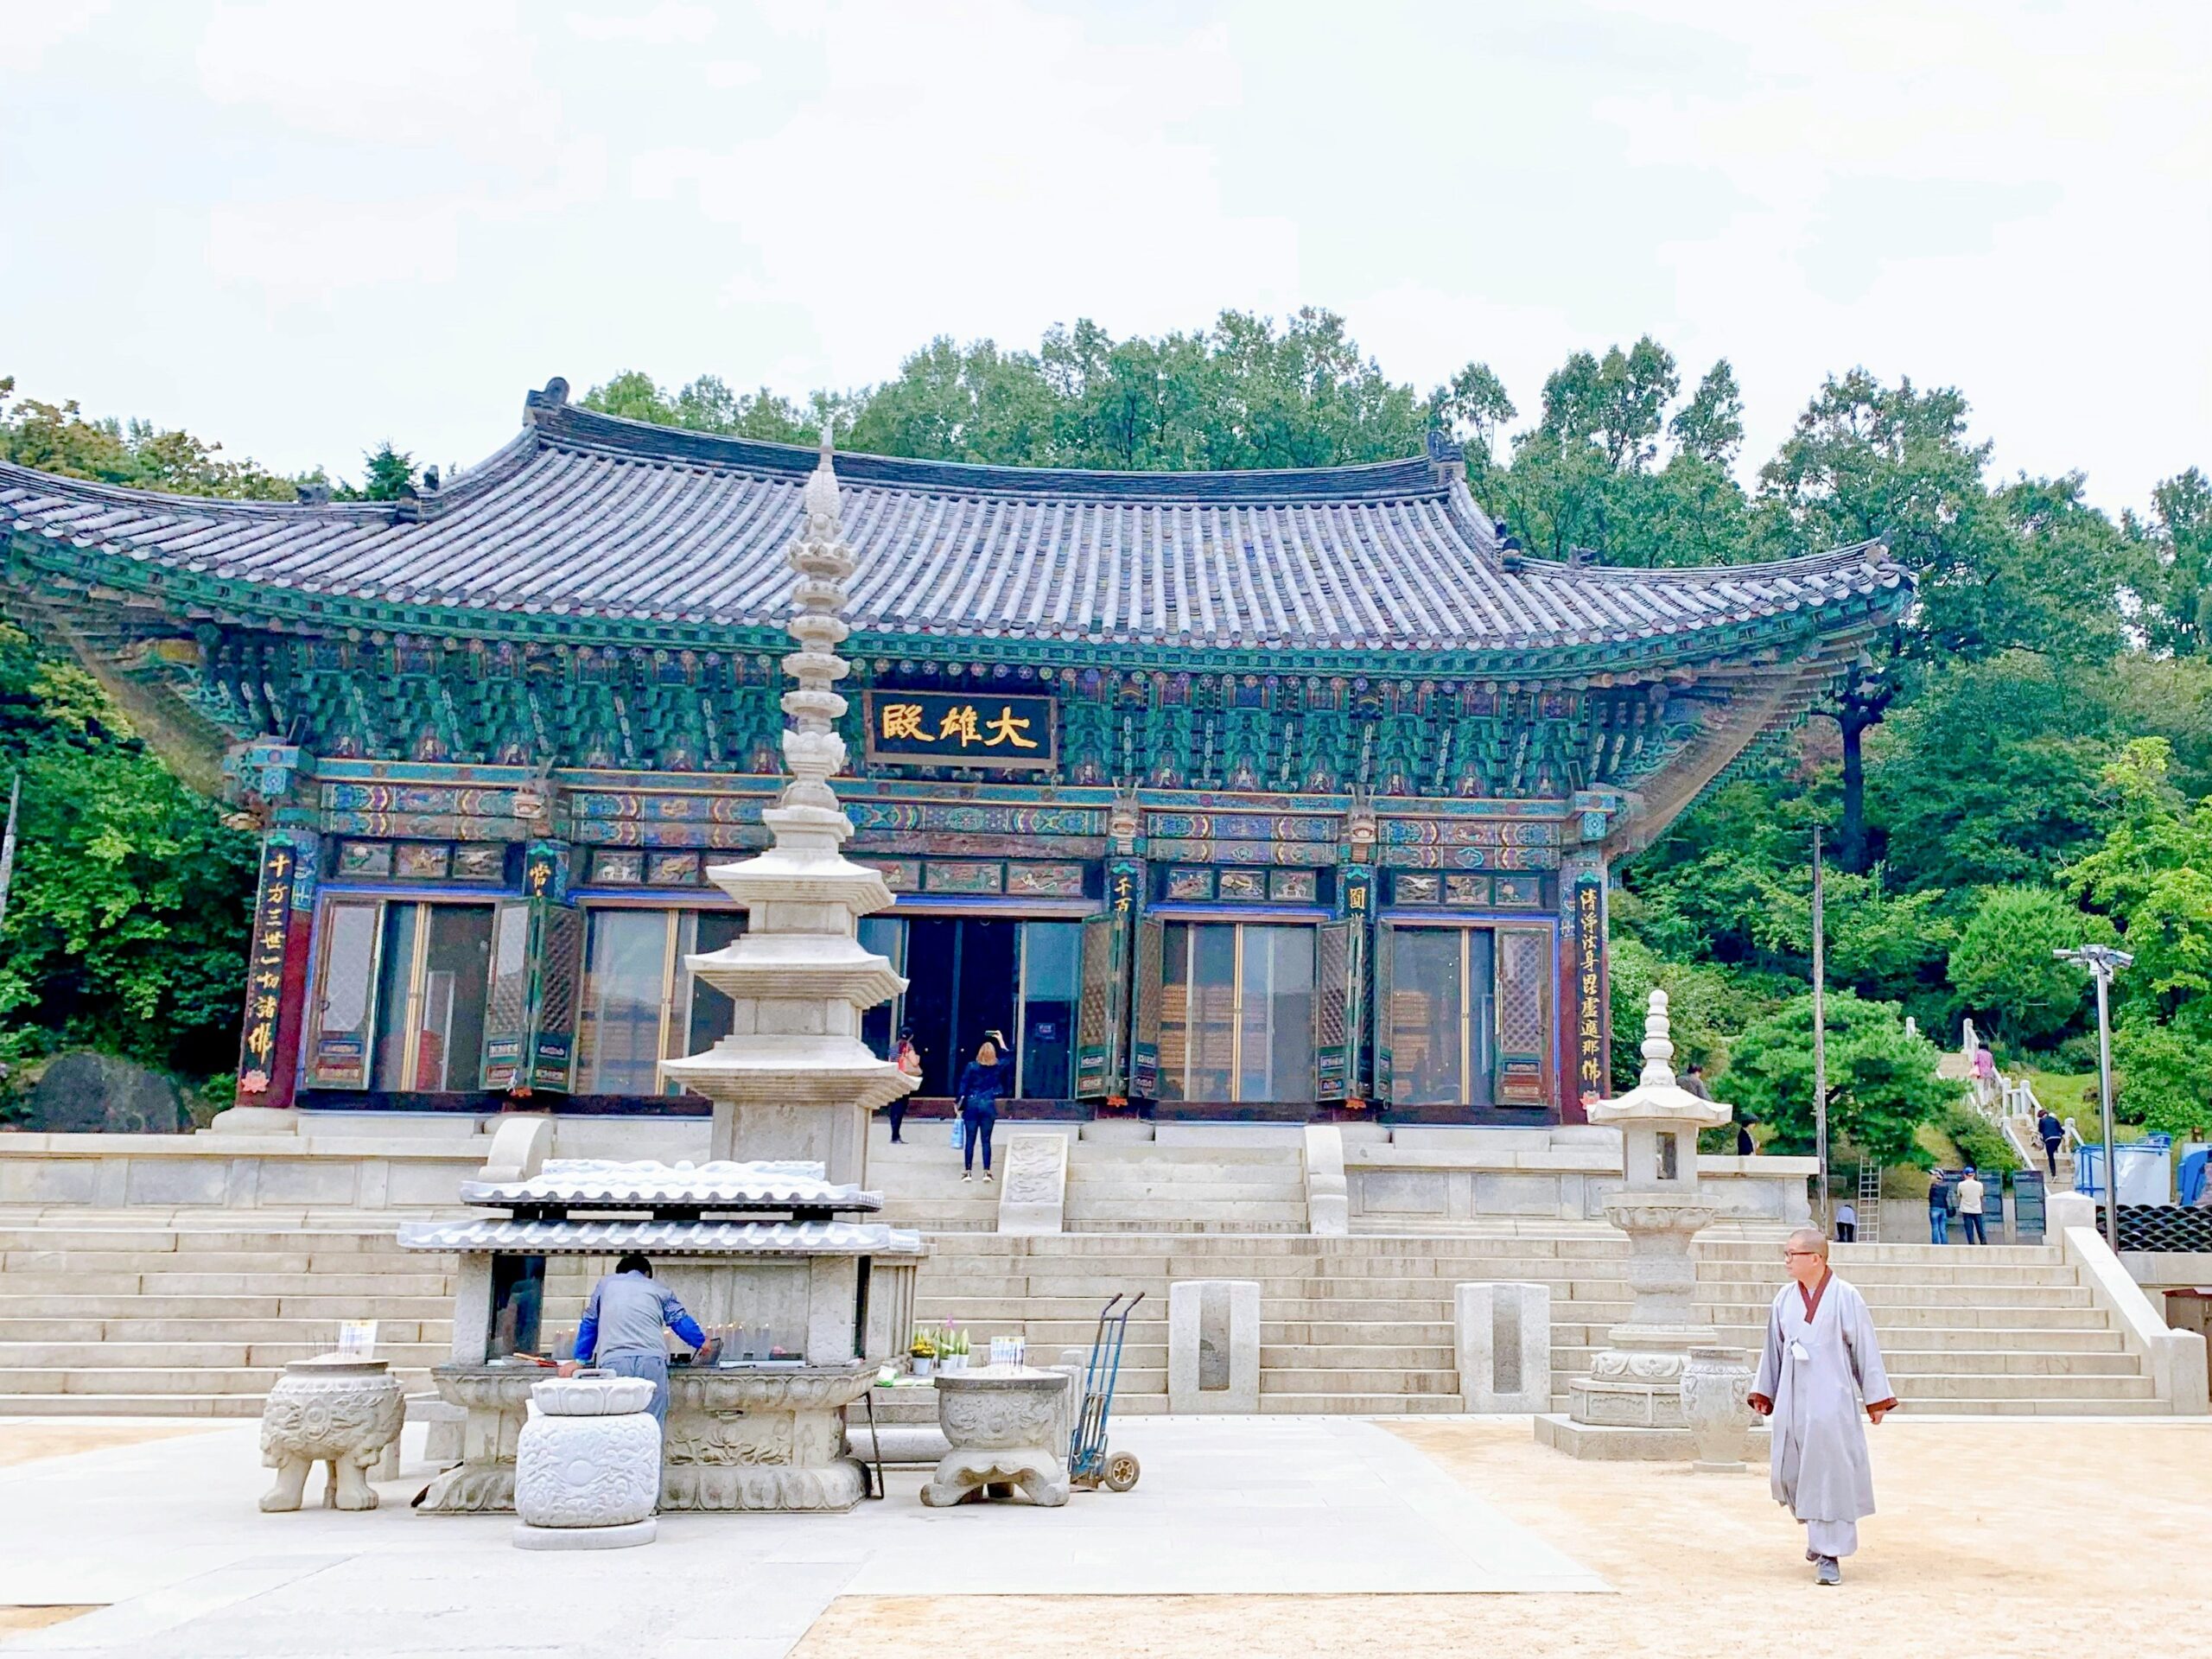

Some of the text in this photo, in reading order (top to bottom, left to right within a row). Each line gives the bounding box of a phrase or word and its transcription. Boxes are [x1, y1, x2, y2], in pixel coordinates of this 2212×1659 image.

[881, 703, 1039, 748] 大雄殿
[1350, 887, 1367, 918] 圓
